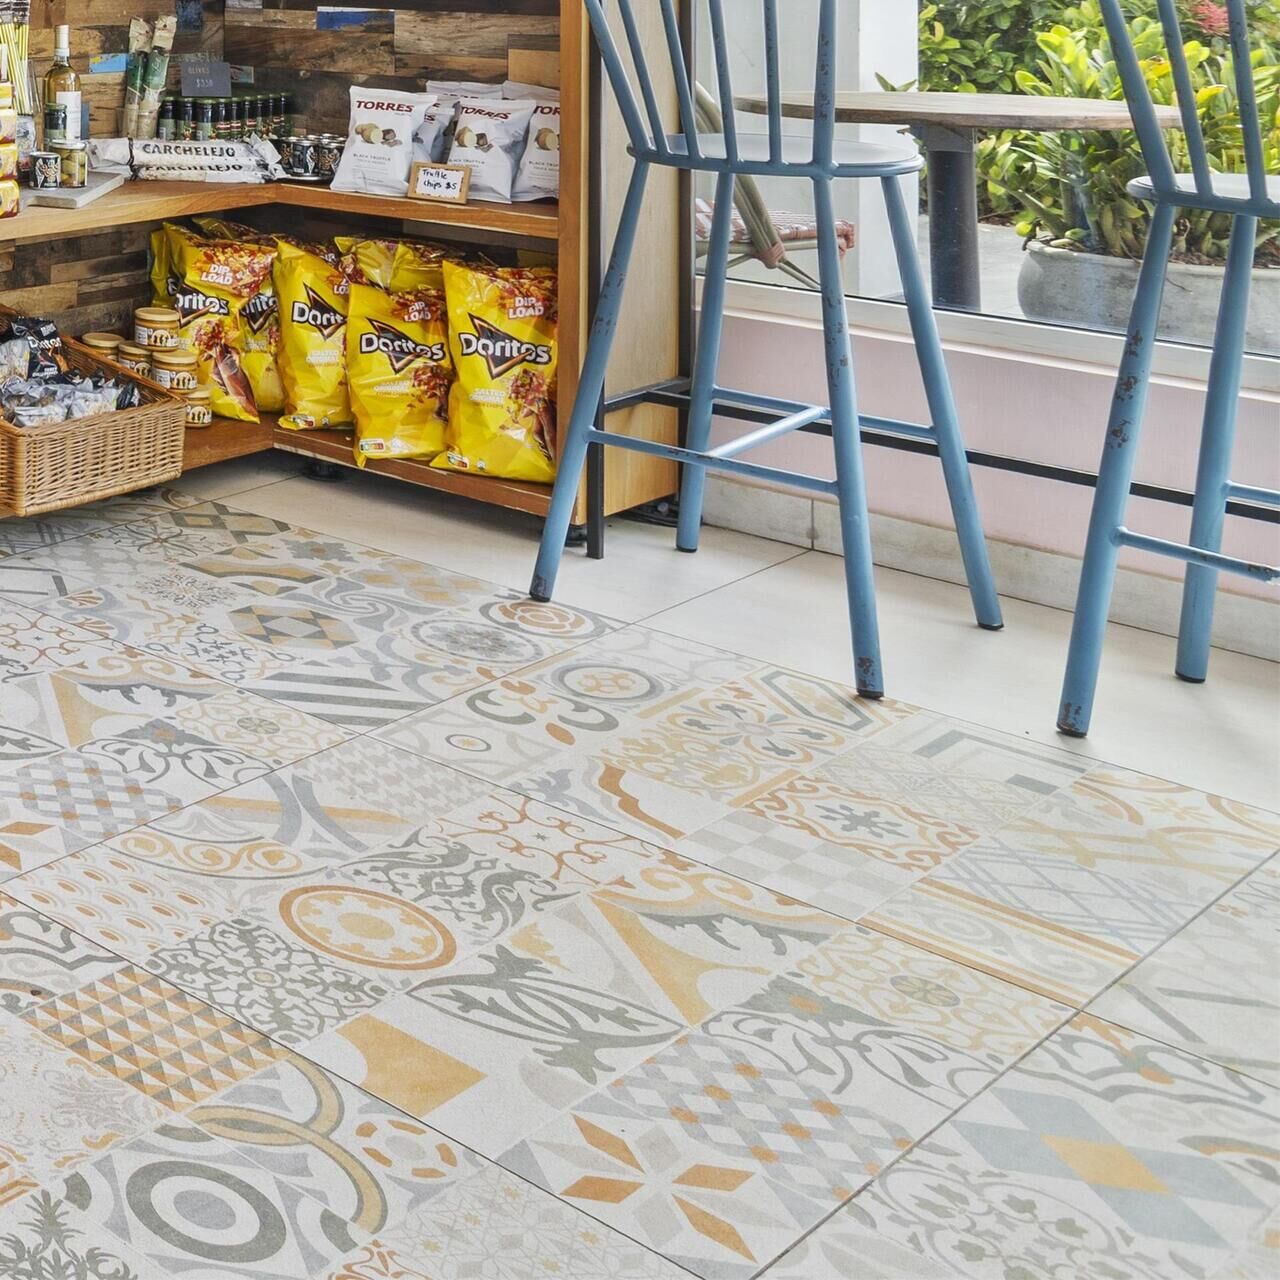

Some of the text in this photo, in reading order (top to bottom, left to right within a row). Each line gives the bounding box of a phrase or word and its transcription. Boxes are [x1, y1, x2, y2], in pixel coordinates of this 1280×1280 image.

[356, 100, 415, 112] TORRES
[534, 105, 560, 116] TOR
[142, 144, 236, 157] CARCHELEJO
[422, 169, 446, 180] Truffle
[444, 180, 457, 190] $5
[209, 263, 231, 274] DIP
[201, 272, 233, 285] LOAD
[409, 301, 426, 312] DIP
[515, 296, 537, 307] DIP
[405, 310, 431, 322] LOAD
[509, 306, 545, 319] LOAD
[28, 335, 62, 351] Doritos
[361, 333, 445, 361] Doritos
[459, 333, 552, 364] Doritos
